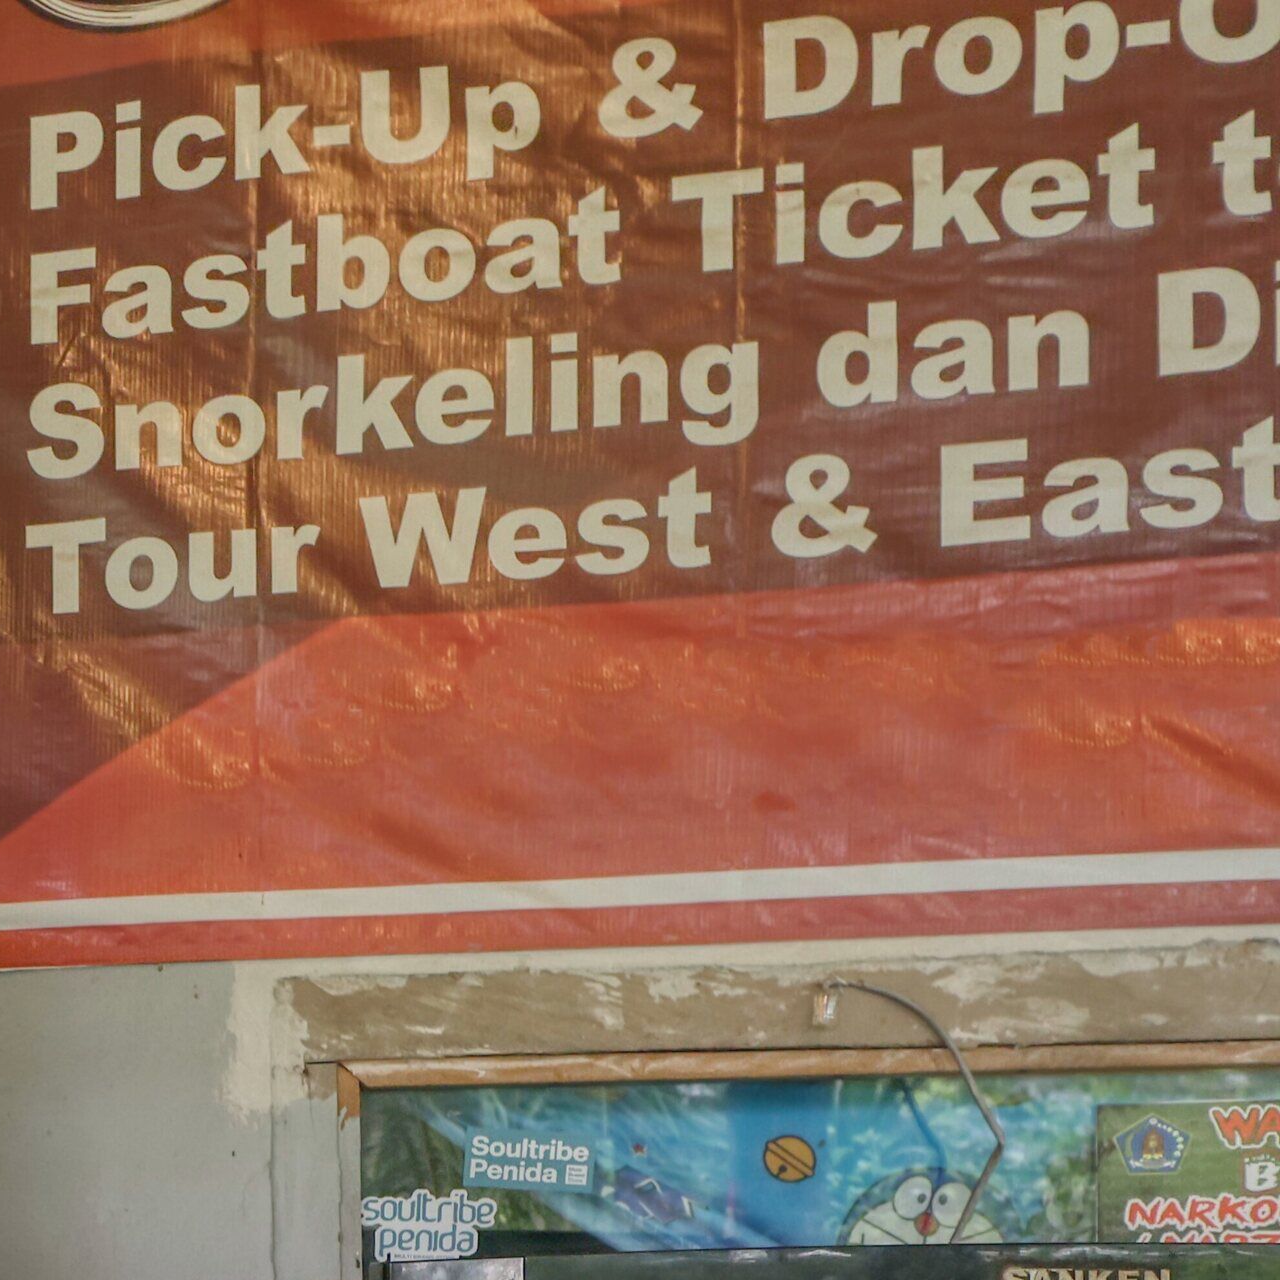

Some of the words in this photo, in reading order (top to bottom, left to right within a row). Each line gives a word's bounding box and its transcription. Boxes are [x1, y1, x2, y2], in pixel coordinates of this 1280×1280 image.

[30, 65, 541, 211] Pick-Up
[598, 37, 703, 138] &
[30, 186, 621, 345] Fastboat
[672, 122, 1155, 272] Ticket
[1213, 109, 1280, 217] t
[27, 332, 760, 479] Snorkeling
[816, 300, 1090, 408] dan
[1158, 266, 1280, 377] D
[25, 518, 320, 613] Tour
[359, 466, 712, 588] West
[771, 453, 878, 559] &
[941, 415, 1280, 548] East
[472, 1135, 589, 1162] Soultribe
[469, 1158, 558, 1184] Penida
[363, 1192, 495, 1225] soultribe
[1125, 1193, 1280, 1231] NARKO
[379, 1225, 475, 1257] penida
